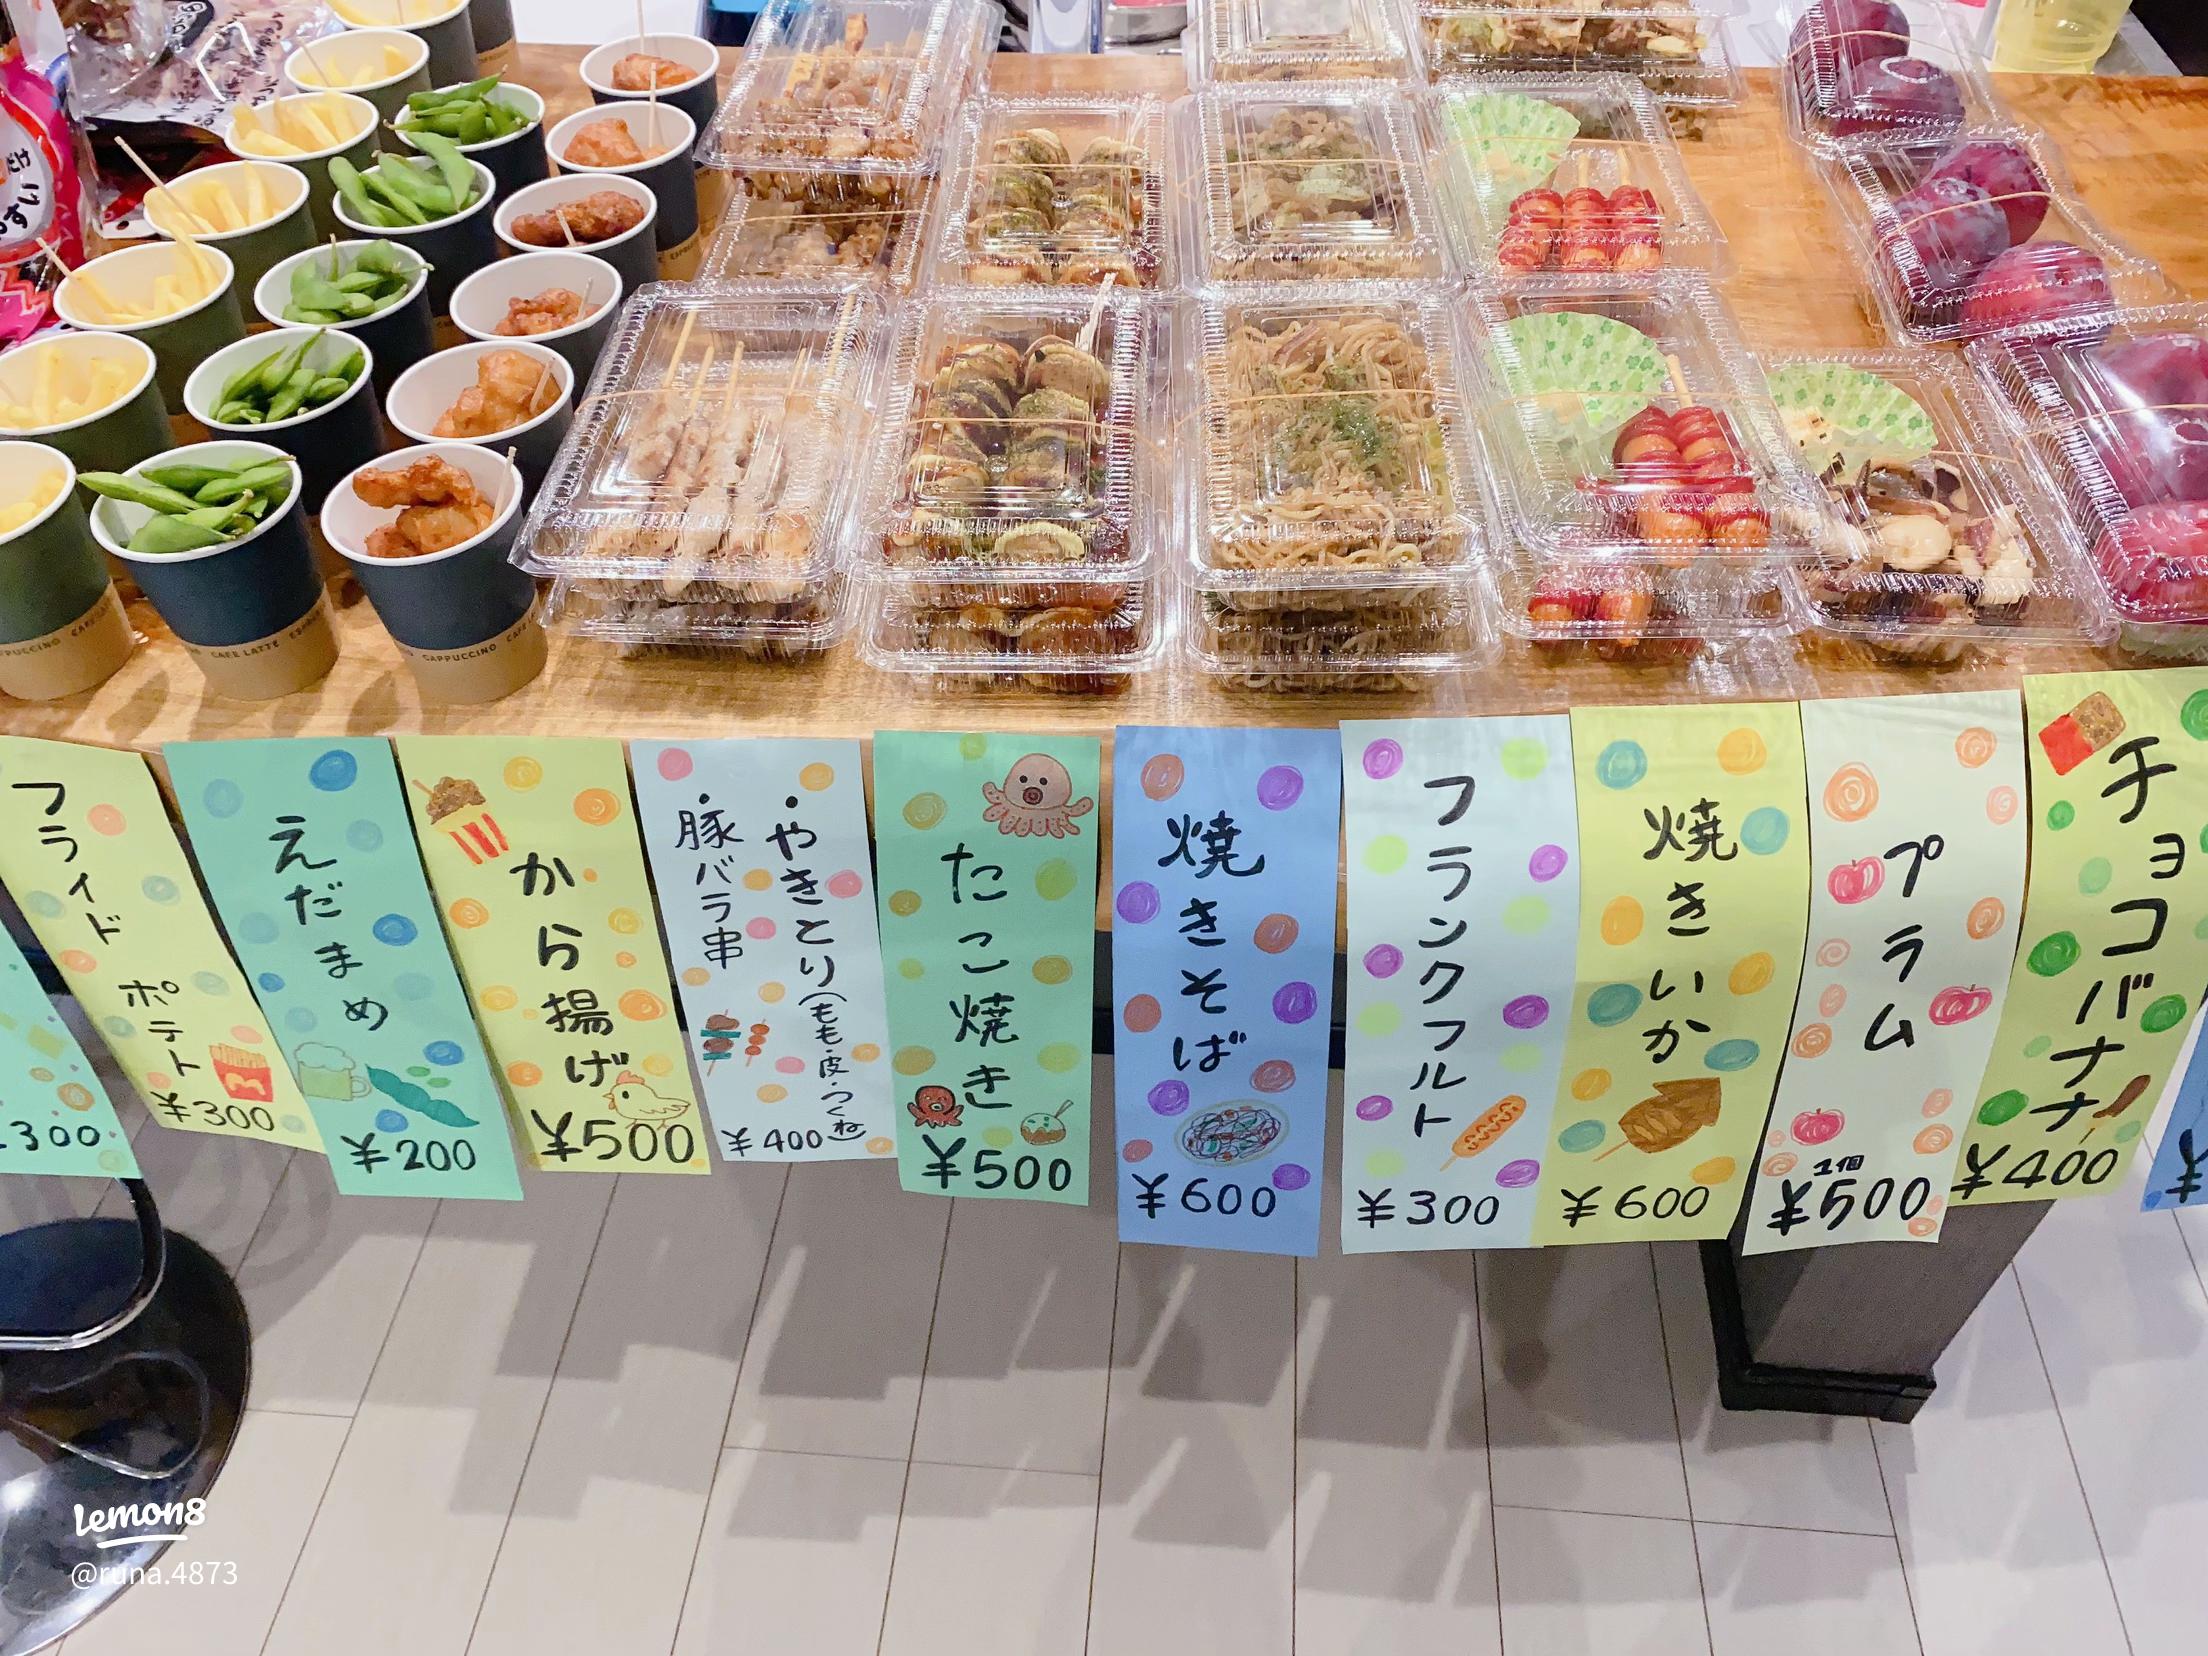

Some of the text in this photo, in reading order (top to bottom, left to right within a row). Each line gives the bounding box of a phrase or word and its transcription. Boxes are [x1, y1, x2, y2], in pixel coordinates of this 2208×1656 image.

[244, 640, 280, 657] LATTE
[422, 643, 497, 662] CAPPUCCINO
[269, 815, 388, 1031] えだまめ
[1158, 809, 1265, 1073] 焼きそば
[1642, 798, 1738, 1063] 焼きいか
[1864, 834, 1944, 1050] プラム
[2030, 736, 2185, 1132] チョコバナナ
[509, 851, 629, 1088] から揚げ
[940, 843, 1020, 1109] たこ焼き
[1410, 775, 1476, 1138] フランクフルト
[0, 1120, 100, 1151] 300
[150, 1090, 275, 1132] ¥300
[530, 1109, 695, 1164] ¥500
[340, 1132, 476, 1174] ¥200
[722, 1127, 823, 1158] ¥400
[921, 1133, 1072, 1190] ¥500
[1813, 1155, 1865, 1177] 1個
[1952, 1142, 2119, 1199] ¥400
[1131, 1172, 1277, 1218] ¥600
[1357, 1187, 1500, 1228] ¥300
[1561, 1185, 1711, 1227] ¥600
[1767, 1177, 1931, 1236] ¥500
